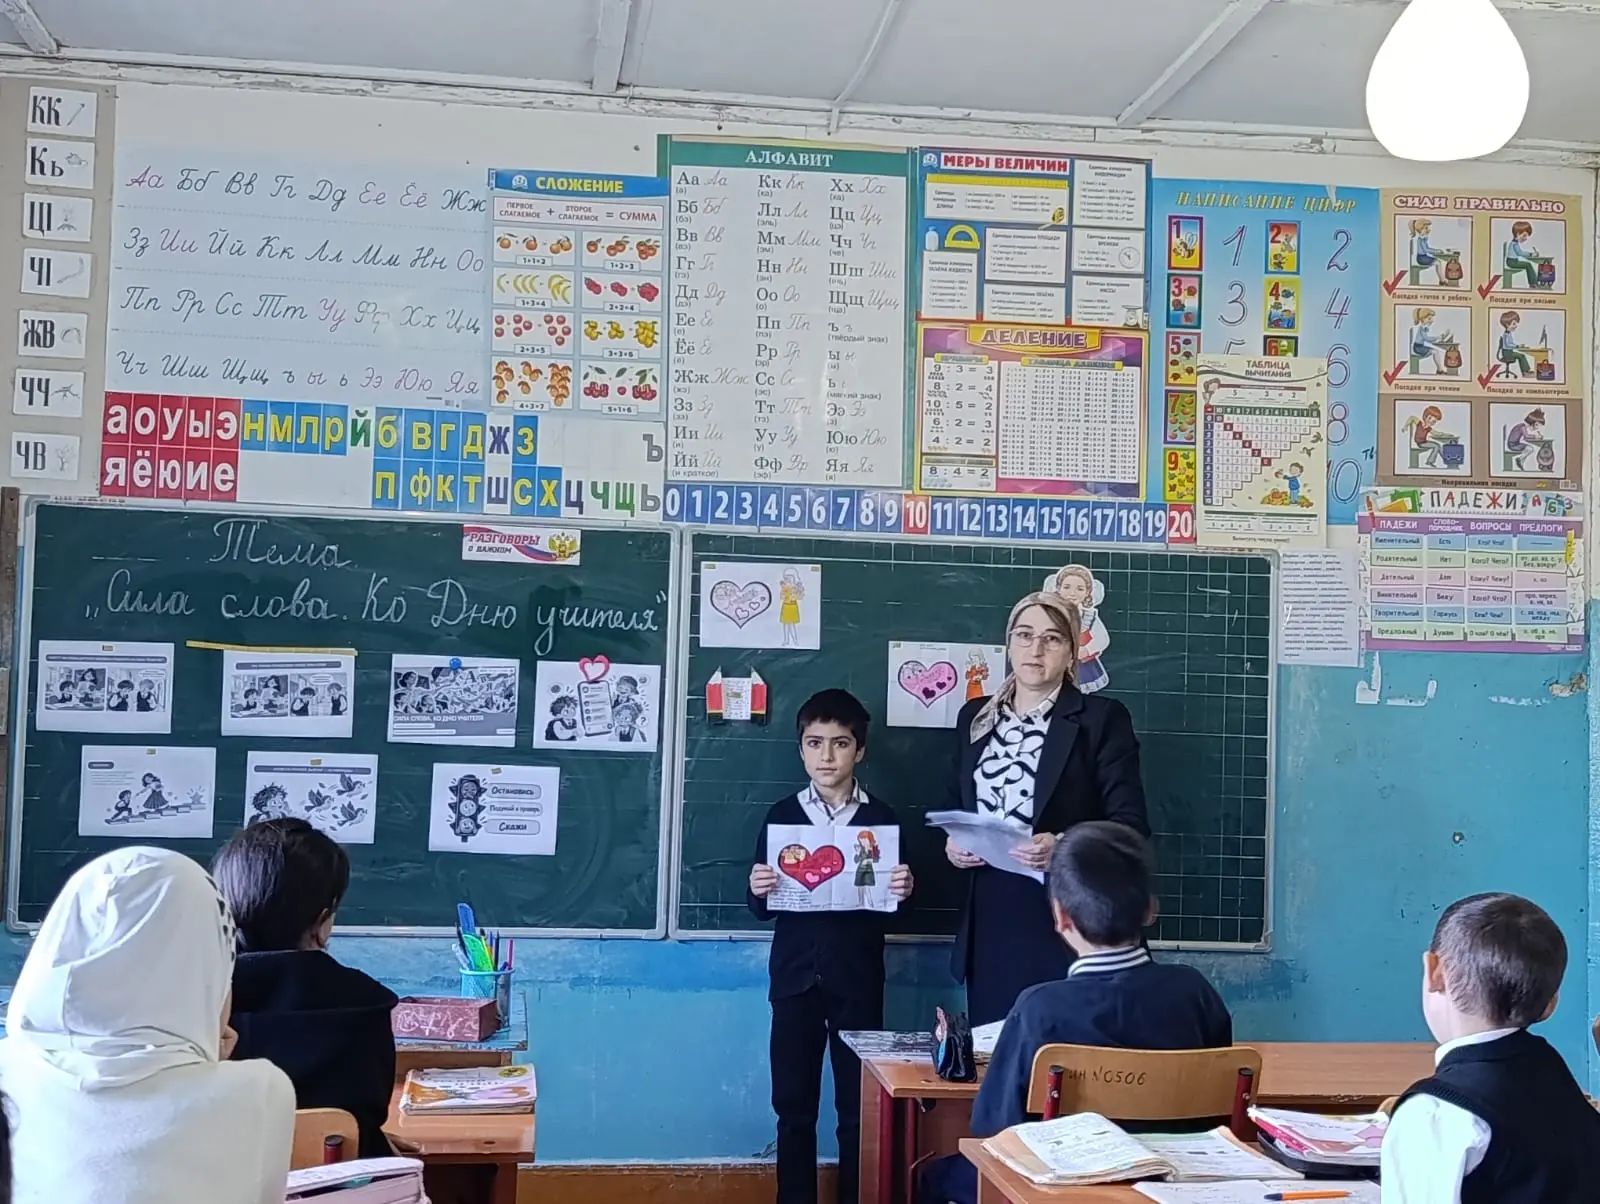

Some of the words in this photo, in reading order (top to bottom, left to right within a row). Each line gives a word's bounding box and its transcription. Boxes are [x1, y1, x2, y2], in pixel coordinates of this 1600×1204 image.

[32, 95, 62, 126] КК
[745, 150, 834, 168] АЛФАВИТ
[943, 155, 990, 169] МЕРЫ
[994, 157, 1068, 173] ВЕЛИЧИН
[536, 177, 624, 193] СЛОЖЕНИЕ
[677, 171, 700, 186] Аа
[758, 175, 782, 189] Кк
[830, 179, 855, 193] Хх
[125, 165, 165, 188] Аа
[177, 168, 220, 191] Бб
[225, 171, 257, 195] Вв
[270, 175, 297, 199] Гг
[308, 179, 347, 212] Дд
[359, 181, 387, 205] Ее
[400, 182, 428, 208] Ёё
[441, 189, 487, 212] Жж
[507, 202, 533, 210] ПЕРВОЕ
[565, 205, 593, 213] ВТОРОЕ
[677, 200, 698, 214] Бб
[758, 203, 781, 217] Лл
[1176, 191, 1296, 209] НАПИСАНИЕ
[1303, 196, 1356, 214] ЦИФР
[1393, 195, 1448, 210] СИДИ
[1454, 197, 1565, 214] ПРАВИЛЬНО
[499, 210, 541, 219] СЛАГАЕМОЕ
[559, 213, 599, 222] СЛАГАЕМОЕ
[619, 211, 657, 222] СУММА
[830, 207, 855, 223] Цц
[677, 227, 698, 241] Вв
[758, 231, 786, 246] Мм
[830, 234, 852, 249] Чч
[124, 227, 149, 258] Зз
[160, 228, 199, 253] Ии
[209, 228, 247, 256] Йй
[256, 236, 295, 260] Кк
[305, 240, 343, 263] Лл
[352, 244, 400, 267] Мм
[409, 246, 448, 270] Нн
[457, 249, 484, 272] Оо
[676, 256, 695, 270] Гг
[757, 259, 782, 273] Нн
[830, 262, 864, 277] Шш
[675, 284, 698, 300] Дд
[756, 287, 778, 302] Оо
[829, 290, 864, 308] Щщ
[1489, 296, 1517, 304] Посадка
[120, 286, 162, 311] Пп
[172, 289, 205, 323] Рр
[215, 292, 243, 316] Сс
[253, 294, 308, 319] Тт
[318, 298, 347, 333] Уу
[400, 305, 438, 329] Хх
[446, 308, 481, 334] Цц
[675, 312, 696, 327] Ее
[756, 315, 781, 330] Пп
[23, 319, 55, 348] ЖВ
[981, 329, 1087, 348] ДЕЛЕНИЕ
[675, 337, 696, 355] Ёё
[756, 344, 778, 360] Рр
[116, 351, 148, 375] Чч
[161, 354, 210, 379] Шш
[222, 358, 269, 385] Щщ
[282, 370, 296, 384] ъ
[307, 372, 327, 386] ы
[339, 374, 348, 387] ь
[360, 367, 383, 389] Ээ
[394, 368, 433, 391] Юю
[444, 371, 480, 394] Яя
[1246, 361, 1290, 370] ТАБЛИЦА
[674, 369, 709, 384] Жж
[755, 372, 776, 386] Сс
[1245, 370, 1292, 378] ВЫЧИТАНИЯ
[21, 377, 50, 407] ЧЧ
[673, 398, 693, 412] Зз
[755, 400, 776, 414] Тт
[826, 403, 845, 416] Ээ
[673, 426, 699, 440] Ии
[755, 429, 778, 445] Уу
[827, 431, 858, 445] Юю
[17, 441, 46, 470] ЧВ
[673, 451, 699, 468] Йй
[754, 457, 782, 473] Фф
[826, 459, 849, 472] Яя
[1431, 491, 1517, 509] ПАДЕЖИ
[666, 487, 681, 517] 0
[691, 490, 702, 518] 1
[714, 490, 729, 519] 2
[739, 492, 752, 520] 3
[763, 493, 778, 521] 4
[788, 494, 801, 522] 5
[811, 496, 826, 524] 6
[836, 497, 850, 525] 7
[860, 498, 875, 526] 8
[884, 499, 899, 527] 9
[906, 500, 927, 529] 10
[933, 502, 952, 530] 11
[959, 503, 982, 532] 12
[986, 504, 1008, 533] 13
[1013, 505, 1036, 534] 14
[1040, 506, 1062, 535] 15
[1067, 507, 1089, 536] 16
[1093, 508, 1115, 536] 17
[1118, 508, 1141, 537] 18
[1145, 509, 1166, 538] 19
[1168, 510, 1192, 538] 20
[1380, 520, 1418, 530] ПАДЕЖИ
[1470, 522, 1512, 531] ВОПРОСЫ
[1519, 523, 1563, 532] ПРЕДЛОГИ
[469, 533, 541, 545] РАЗГОВОРЫ
[476, 546, 513, 554] ВАЖНОМ
[1380, 573, 1415, 582] Дательный
[361, 572, 407, 623] Ко
[427, 578, 517, 629] Дню
[1377, 591, 1418, 599] Винительный
[1375, 610, 1420, 618] Творительный
[1378, 628, 1417, 636] Предложный
[492, 786, 534, 795] Остановись
[499, 822, 527, 831] Скажи
